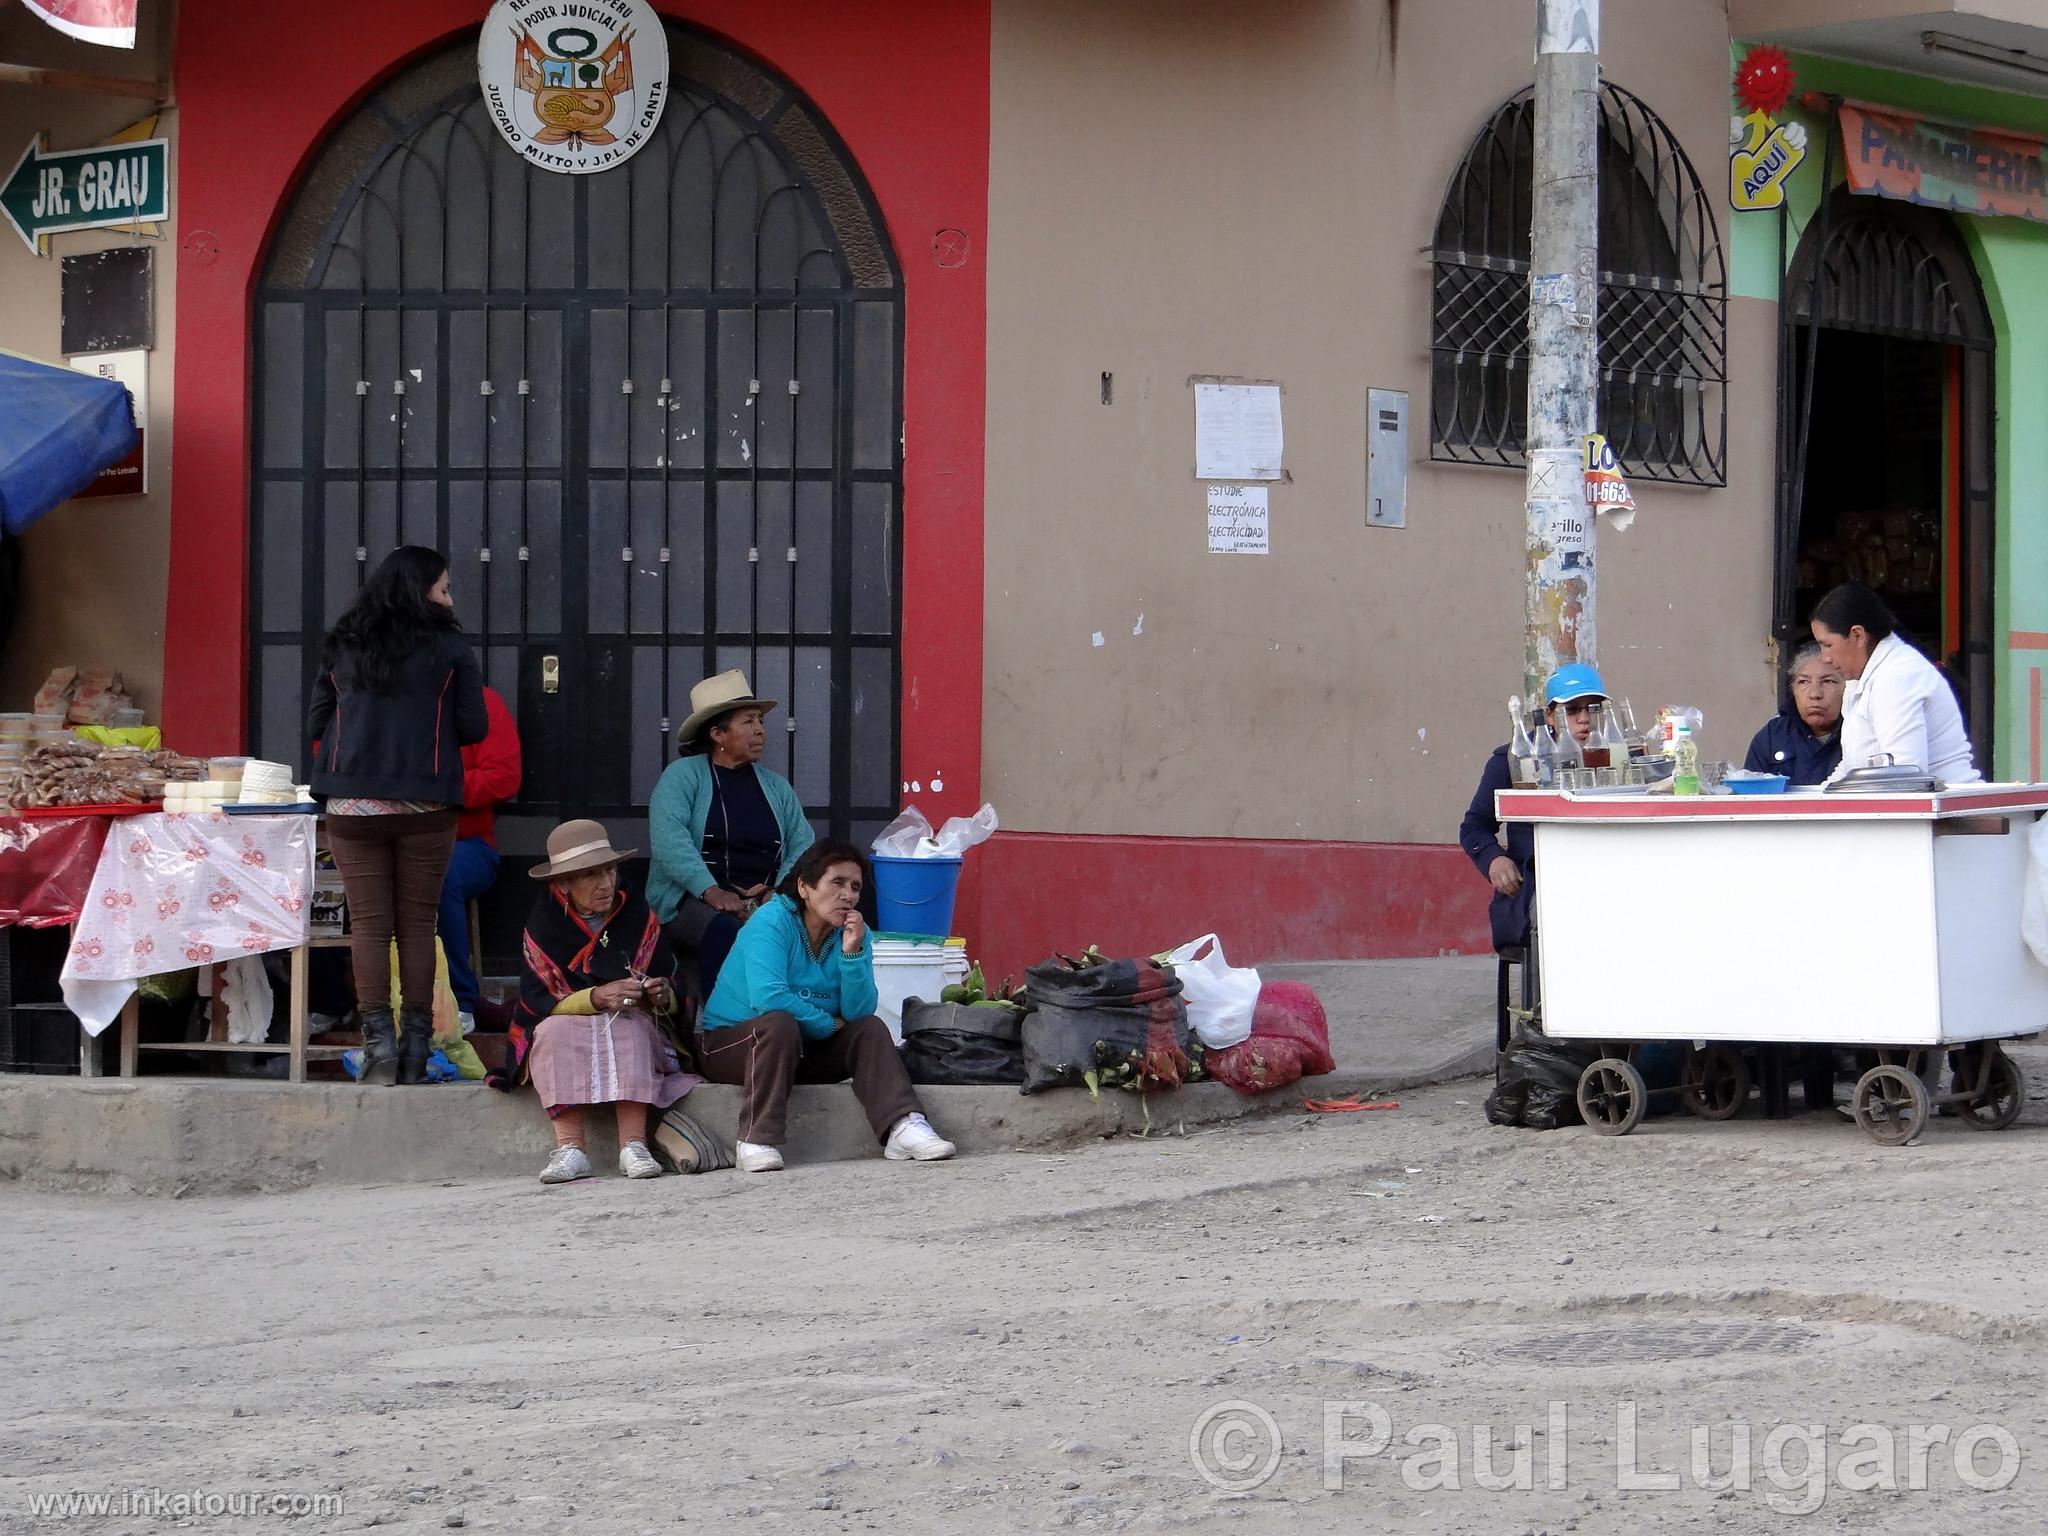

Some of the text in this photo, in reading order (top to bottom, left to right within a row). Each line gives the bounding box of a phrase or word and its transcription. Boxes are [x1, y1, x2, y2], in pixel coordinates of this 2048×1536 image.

[524, 4, 617, 31] PODER JUDICIAL
[488, 81, 662, 168] JUZGADO MIXTO Y J.P.L. DE CANTA
[1743, 141, 1787, 200] AQUÍ
[32, 155, 149, 218] JR. GRAU
[1587, 440, 1620, 471] LO
[1208, 485, 1244, 497] ESTUDIE
[1208, 502, 1266, 518] ELECTRÓNICA
[1208, 525, 1264, 538] ELECTRICIDAD
